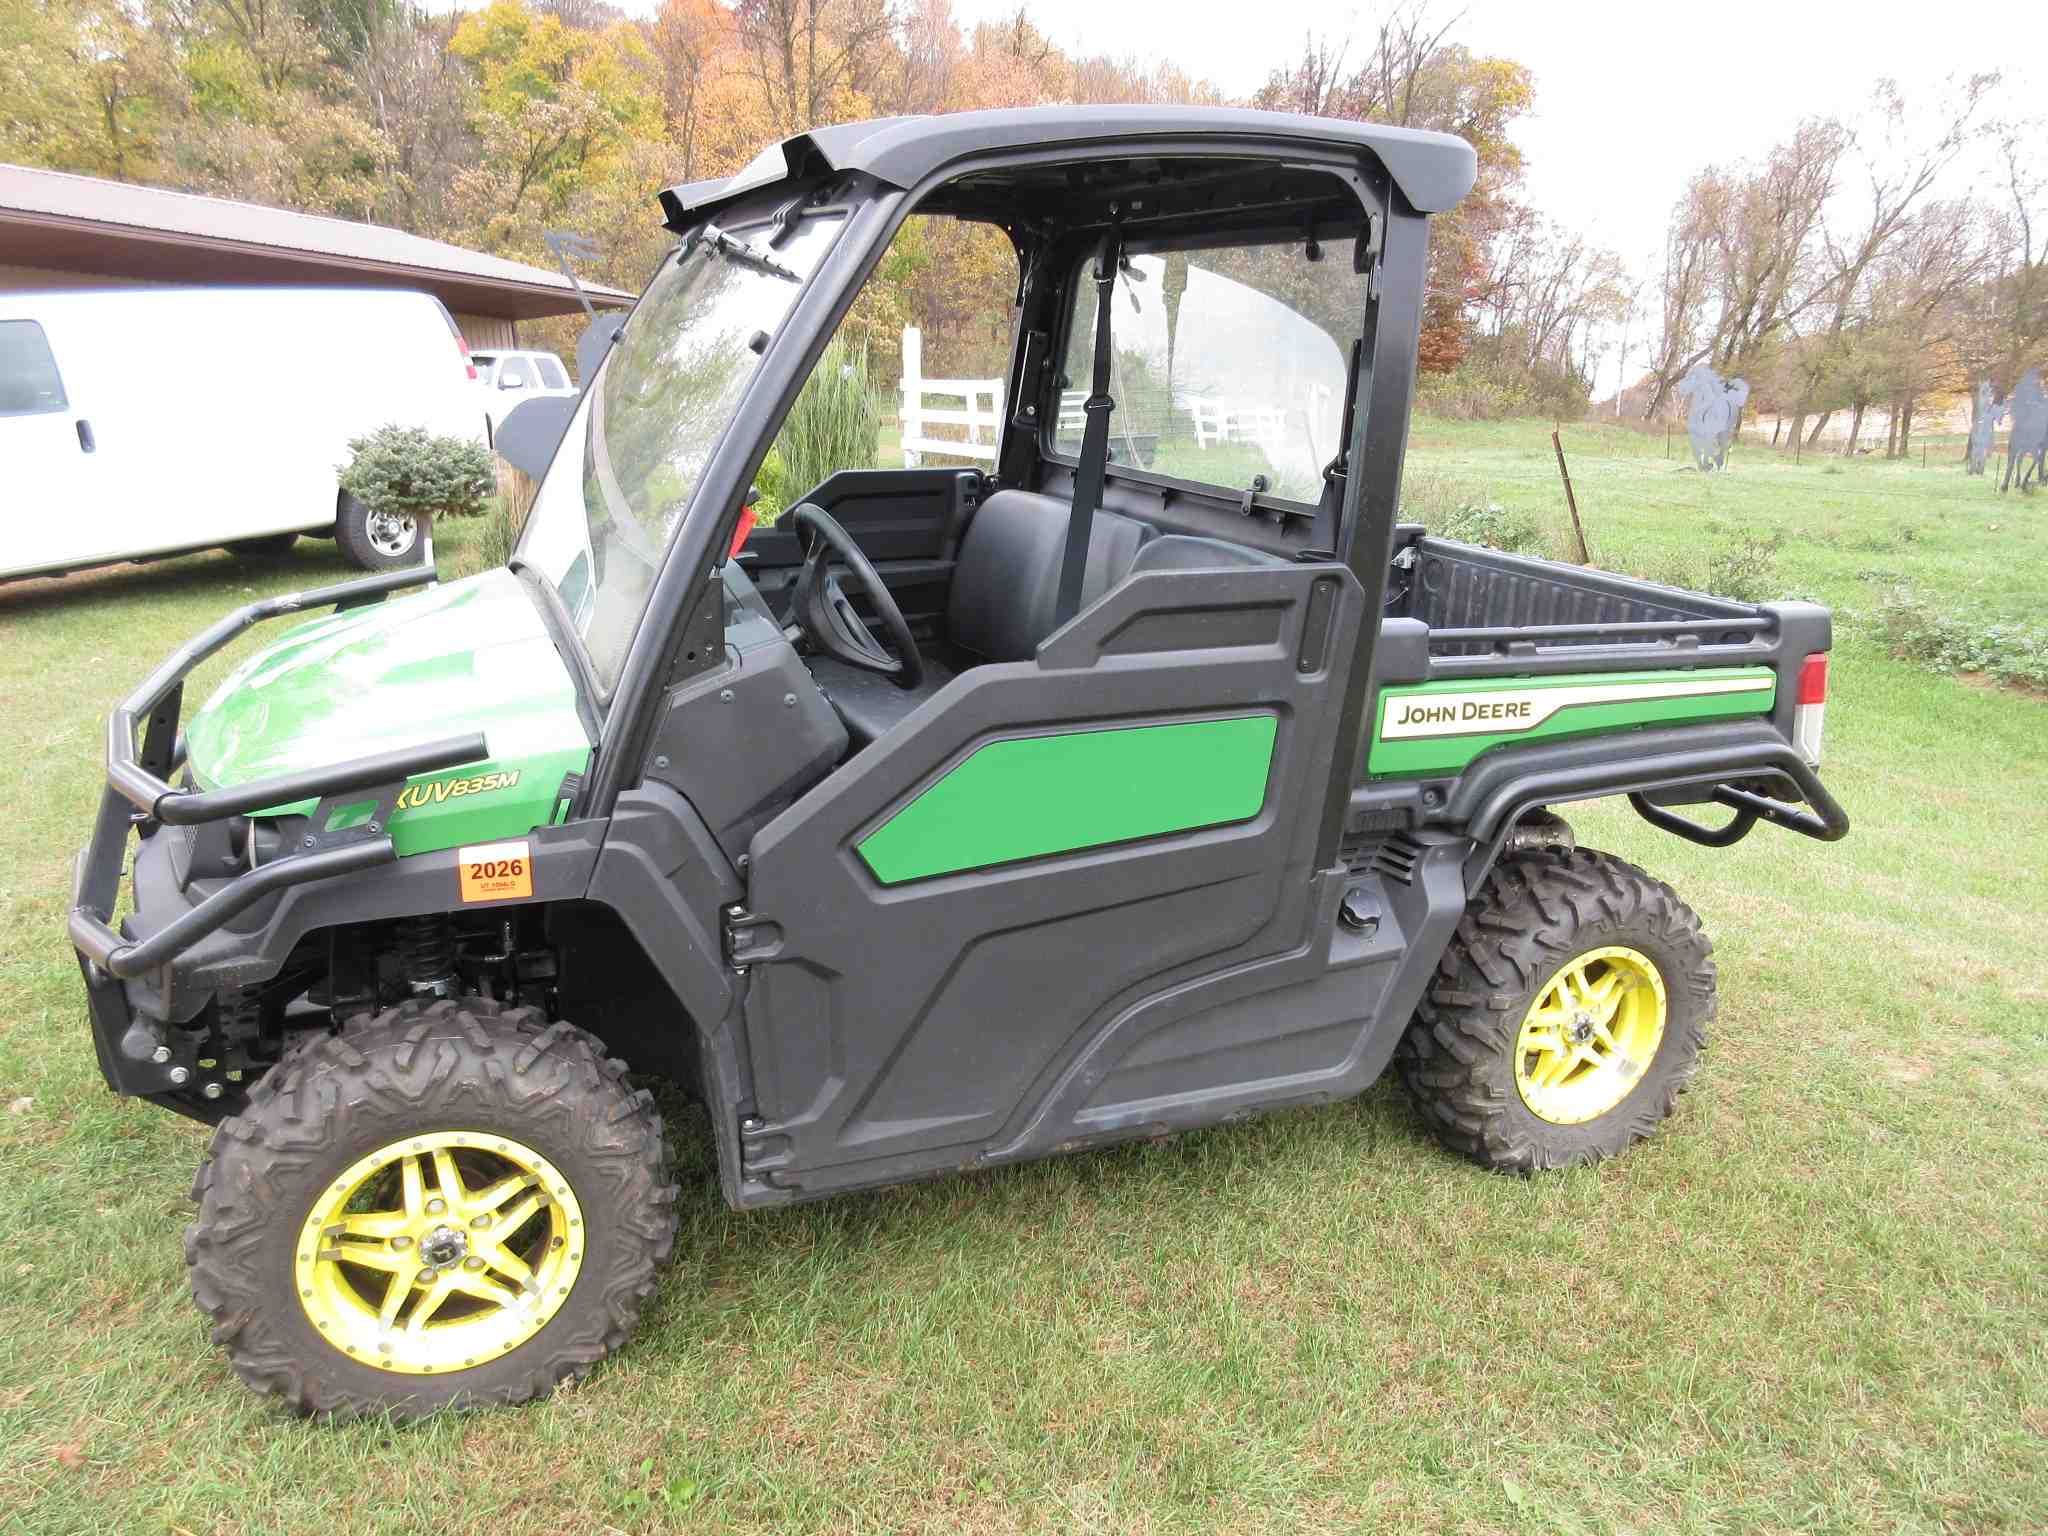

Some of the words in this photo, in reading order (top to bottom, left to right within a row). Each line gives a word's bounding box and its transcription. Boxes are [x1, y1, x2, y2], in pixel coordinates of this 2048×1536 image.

[1398, 705, 1456, 725] JOHN
[1462, 702, 1532, 721] DEERE
[470, 860, 522, 880] 2026
